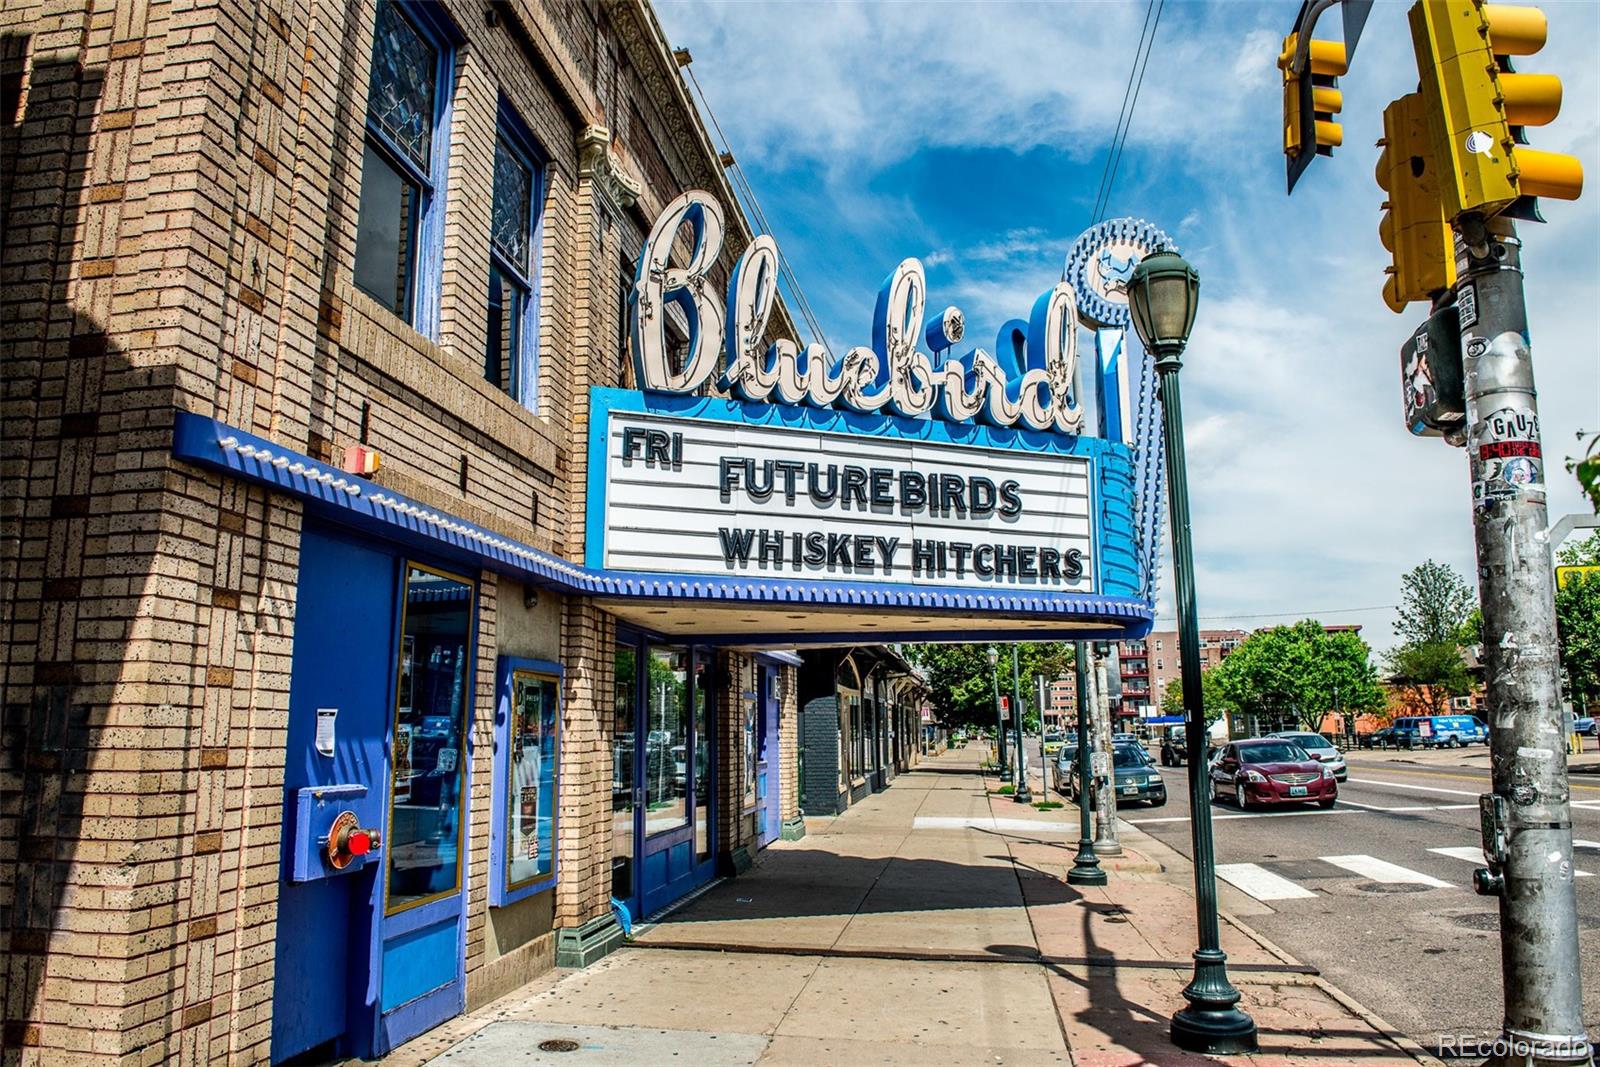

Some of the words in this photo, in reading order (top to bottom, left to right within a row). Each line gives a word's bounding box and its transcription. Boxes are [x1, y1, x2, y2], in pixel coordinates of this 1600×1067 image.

[634, 189, 1084, 433] Bluebird
[623, 427, 683, 464] FRI
[720, 456, 1022, 515] FUTUREBIRDS
[718, 527, 899, 572] WHISKEY
[913, 539, 1083, 579] HITCHERS
